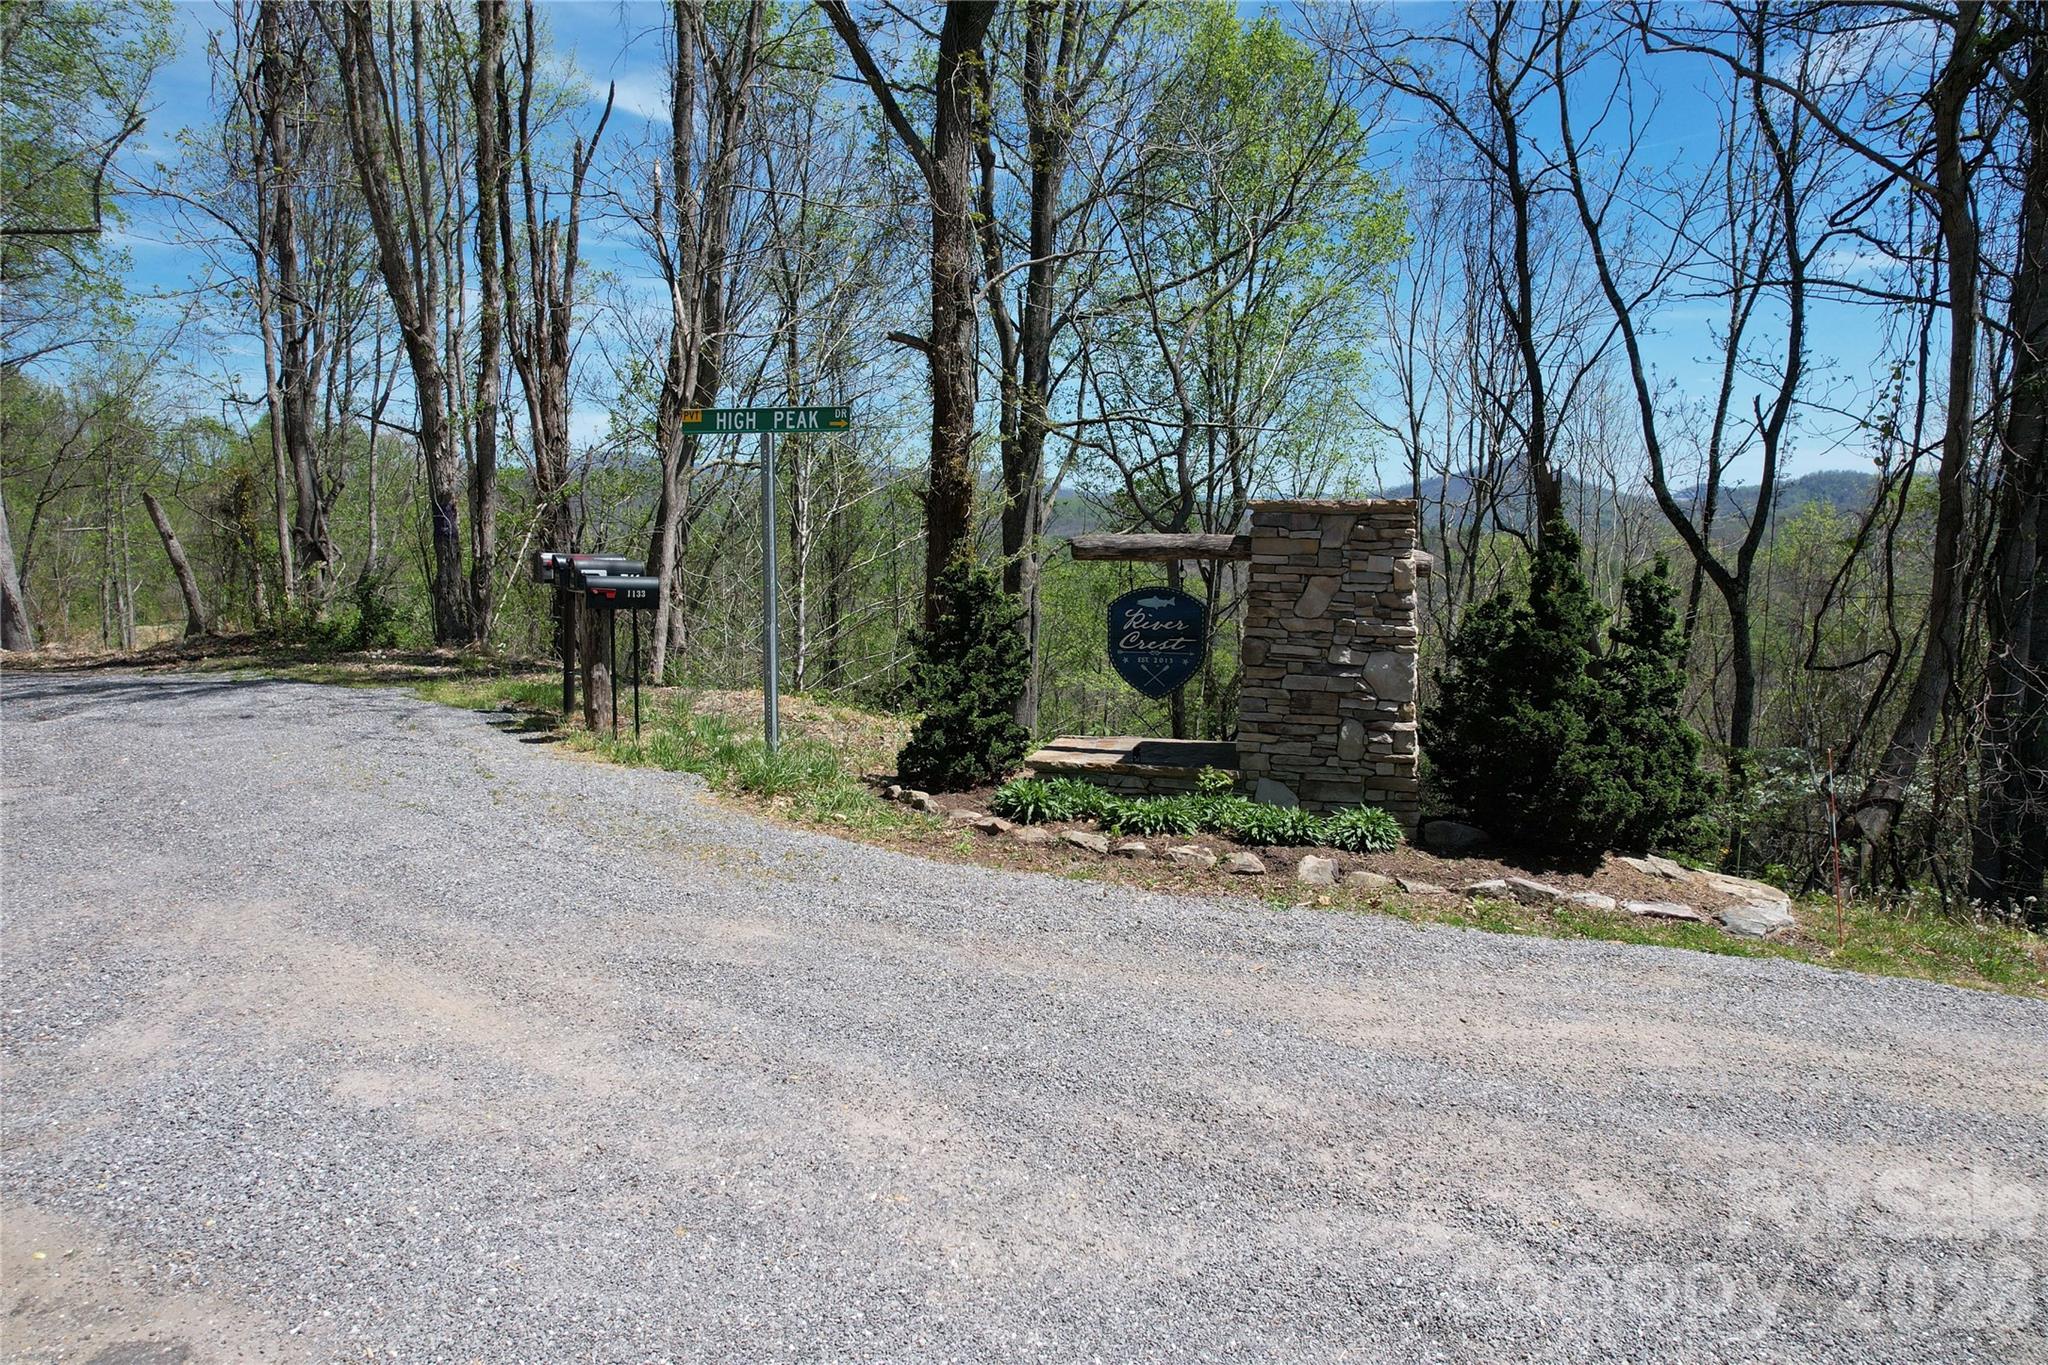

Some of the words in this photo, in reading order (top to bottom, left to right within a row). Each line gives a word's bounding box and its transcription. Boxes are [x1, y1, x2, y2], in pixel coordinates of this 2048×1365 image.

[683, 412, 700, 421] PVT
[716, 412, 756, 430] HIGH
[774, 411, 819, 429] PEAK
[834, 409, 847, 418] DR
[627, 590, 646, 598] 1133
[1124, 608, 1189, 630] River
[1119, 631, 1197, 650] Crest
